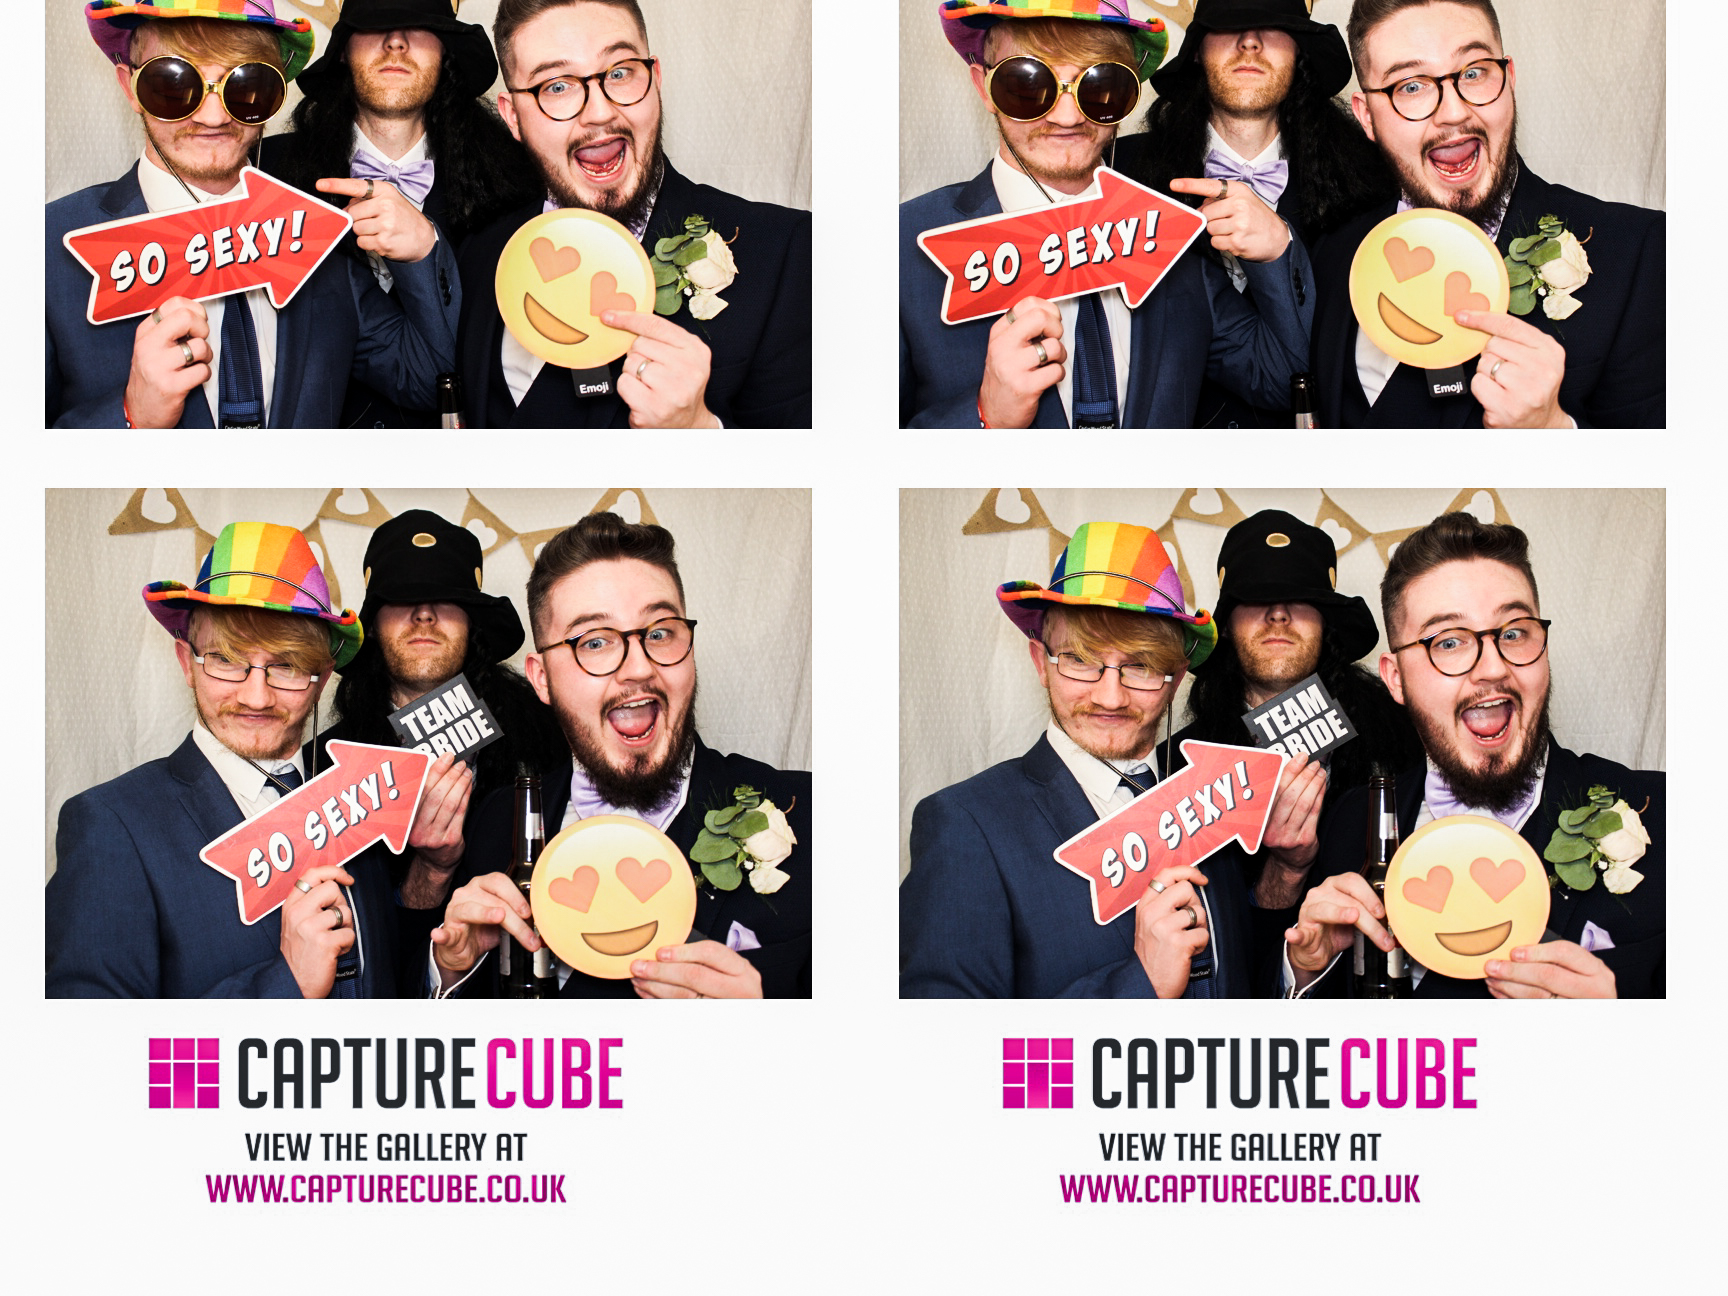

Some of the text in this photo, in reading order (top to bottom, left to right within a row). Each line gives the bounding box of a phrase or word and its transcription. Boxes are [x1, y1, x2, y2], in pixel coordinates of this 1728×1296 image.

[110, 209, 307, 292] SO SEXY!
[964, 209, 1161, 292] SO SEXY!
[579, 381, 609, 394] Emoji
[1433, 381, 1463, 394] Emoji
[399, 683, 475, 742] TEAM
[1253, 683, 1329, 742] TEAM
[247, 760, 400, 888] SO SEXY!
[1101, 760, 1254, 888] SO SEXY!
